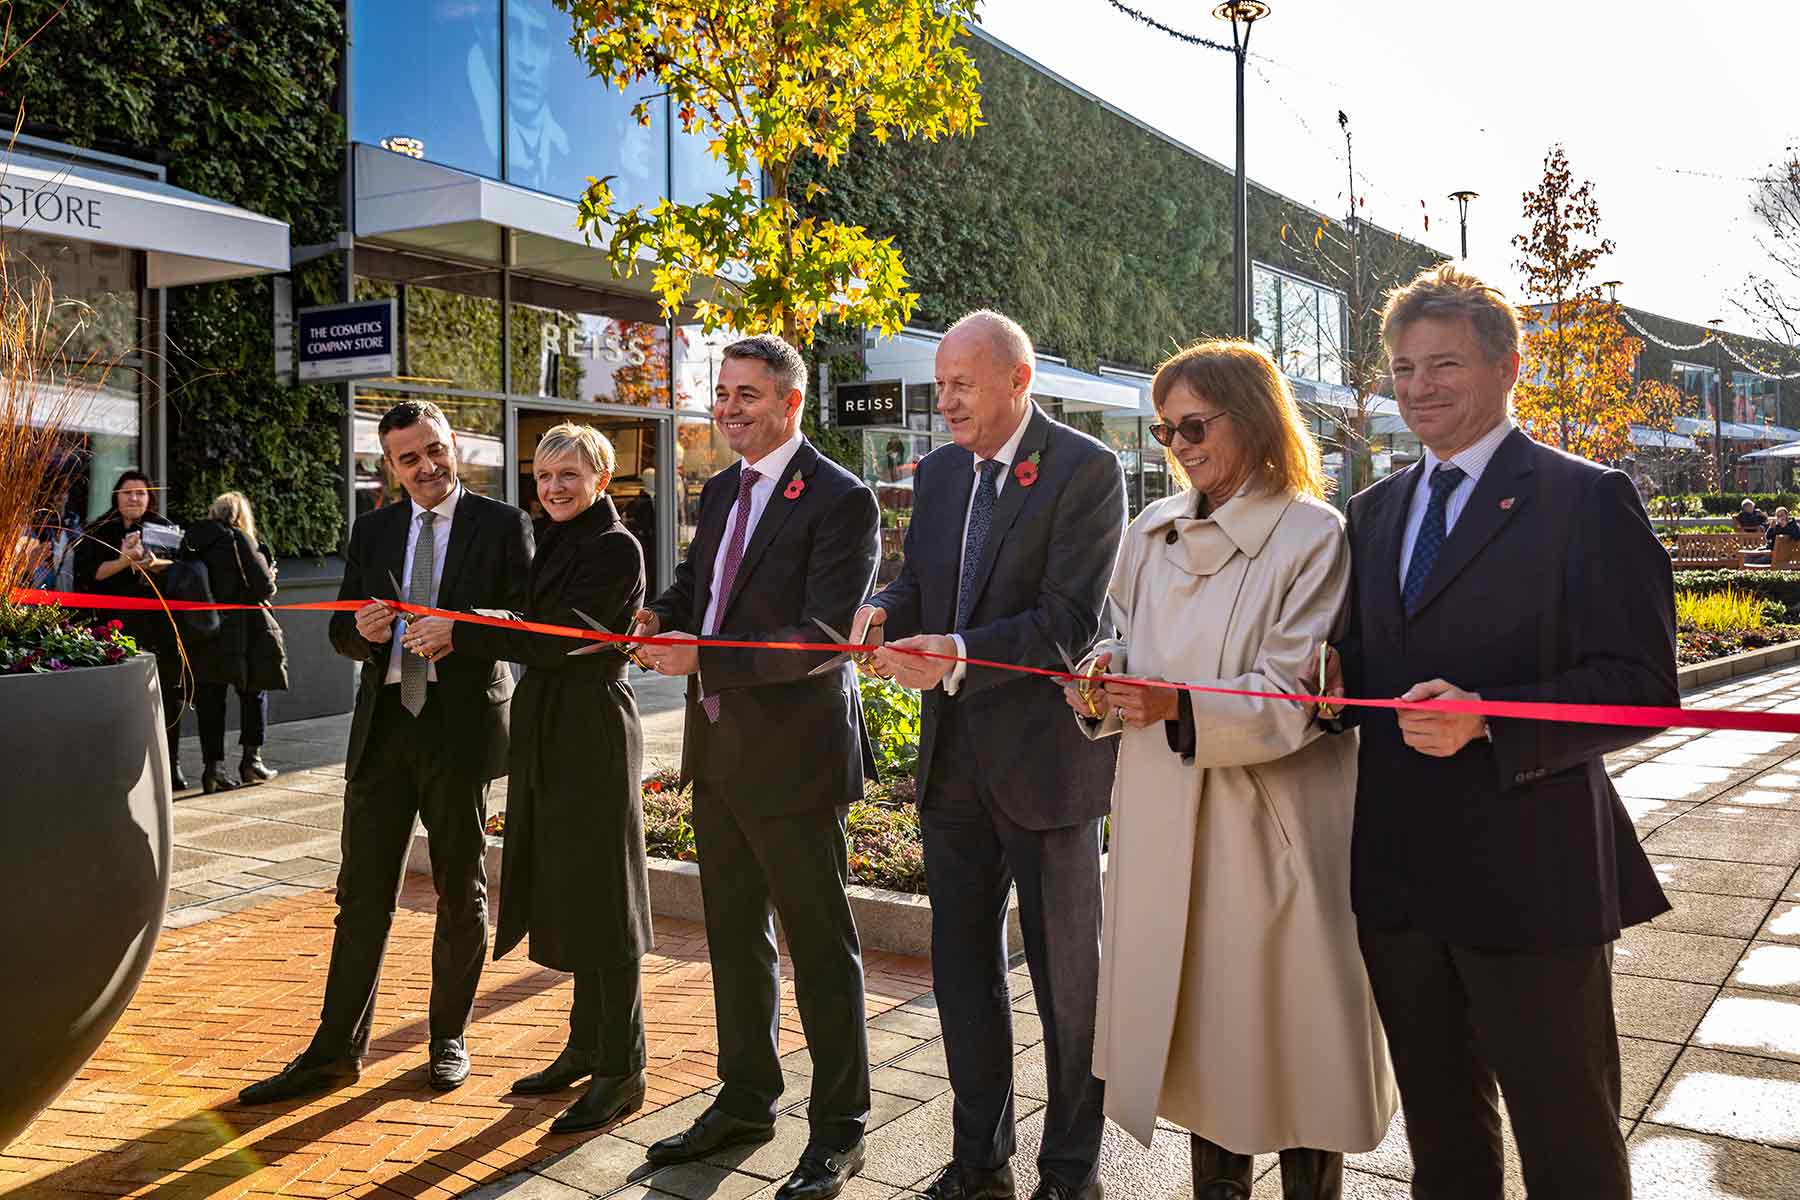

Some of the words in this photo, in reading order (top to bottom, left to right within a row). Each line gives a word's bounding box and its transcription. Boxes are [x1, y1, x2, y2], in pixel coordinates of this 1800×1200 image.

[0, 184, 102, 229] STORE
[310, 327, 328, 338] THE
[330, 321, 382, 337] COSMETICS
[307, 340, 353, 354] COMPANY
[354, 336, 384, 350] STORE
[541, 323, 645, 366] REISS
[846, 398, 894, 411] REISS
